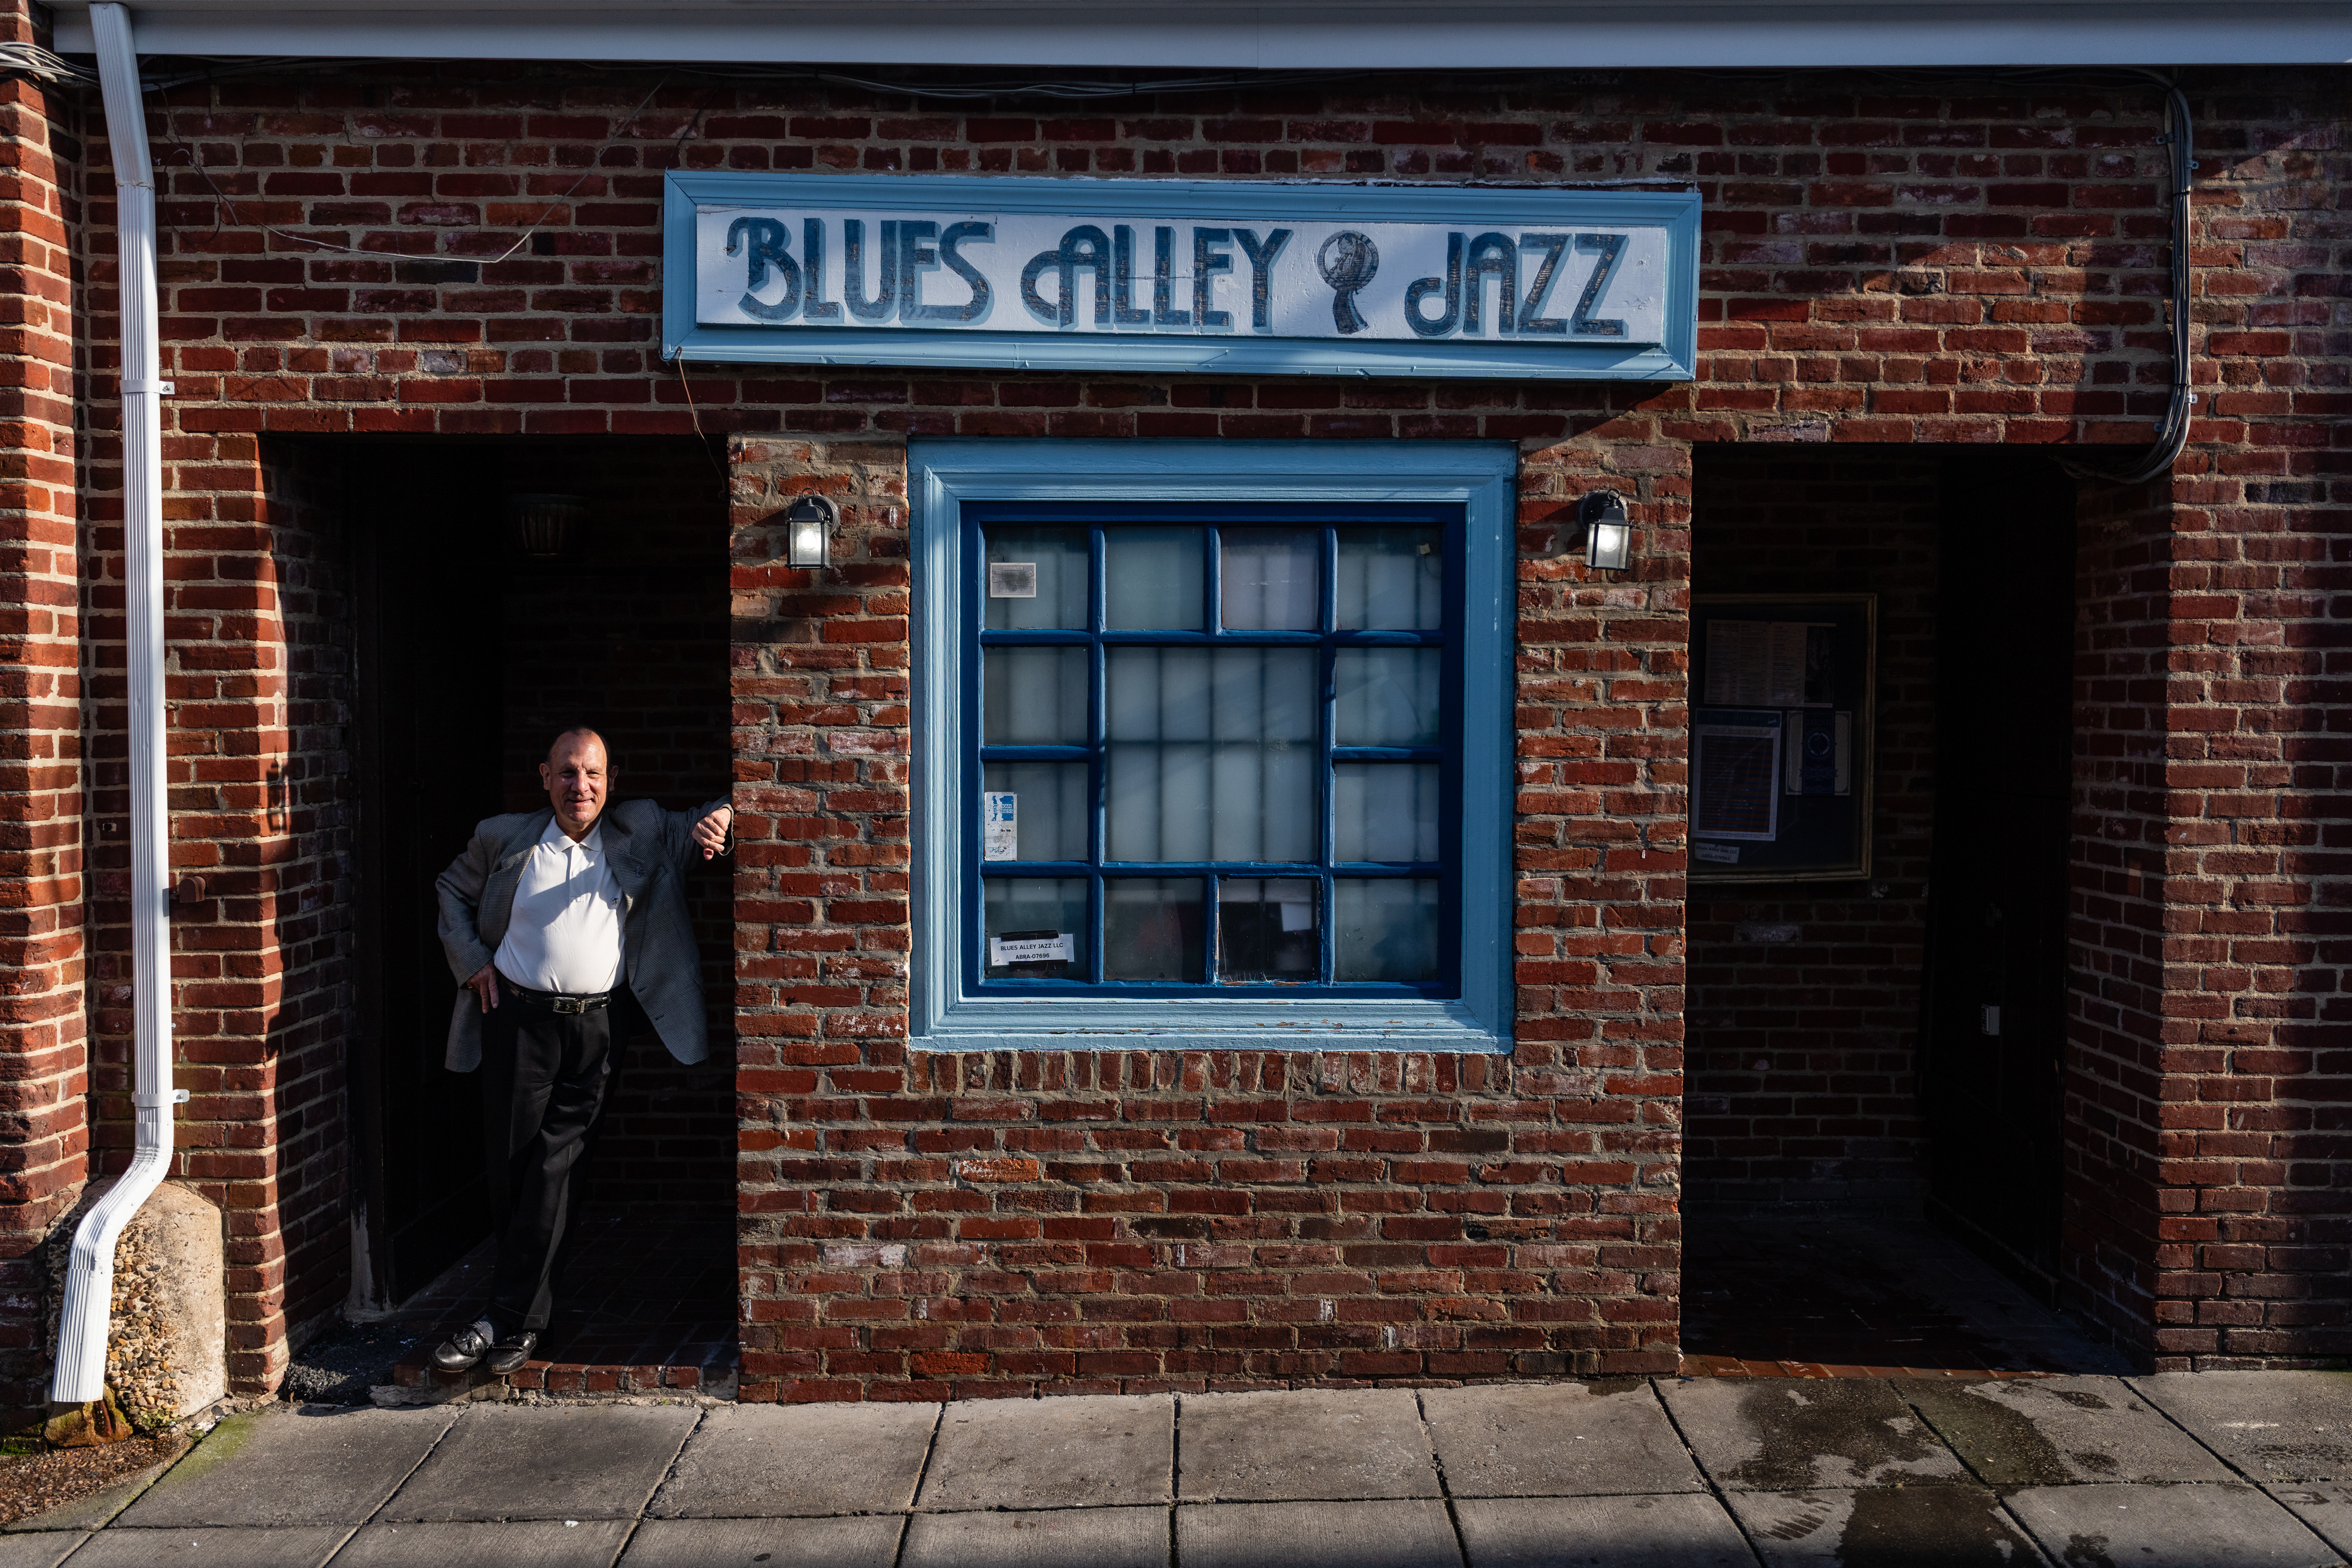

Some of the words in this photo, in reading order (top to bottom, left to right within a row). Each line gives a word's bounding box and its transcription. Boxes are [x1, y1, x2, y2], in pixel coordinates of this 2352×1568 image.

[723, 216, 994, 325] BLUES
[1021, 223, 1293, 333] ALLEY
[1405, 232, 1628, 339] JAZZ
